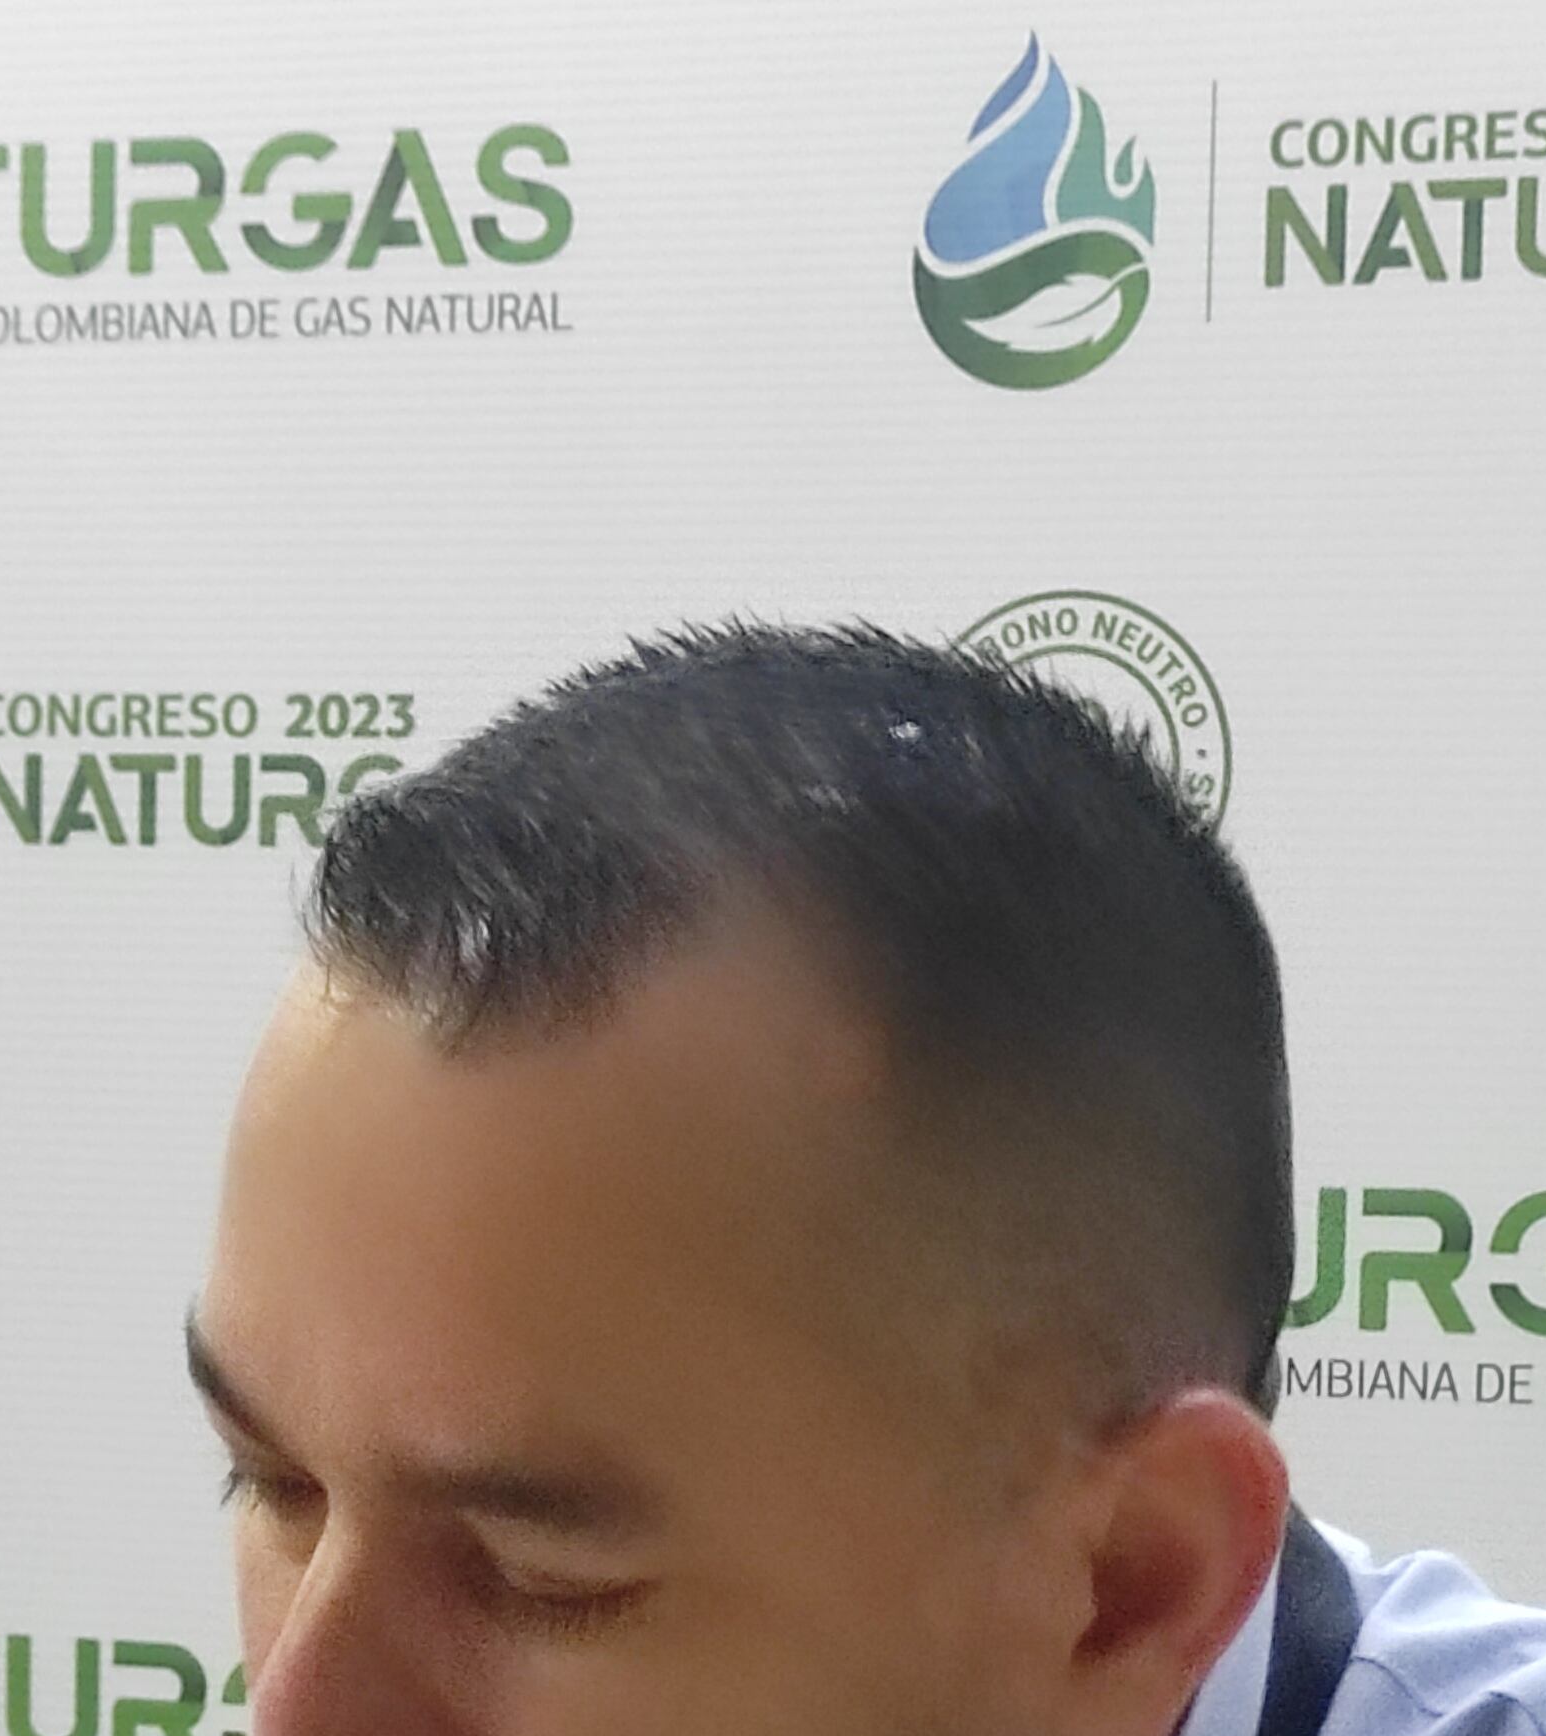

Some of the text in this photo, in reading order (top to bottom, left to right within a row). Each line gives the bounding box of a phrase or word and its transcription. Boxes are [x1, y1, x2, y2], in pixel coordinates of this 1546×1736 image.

[230, 299, 279, 340] DE
[294, 296, 371, 336] GAS
[385, 291, 574, 335] NATURAL
[1091, 611, 1208, 728] NEUTRO
[285, 693, 415, 739] 2023
[1286, 1357, 1458, 1403] MBIANA
[1476, 1362, 1534, 1404] DE
